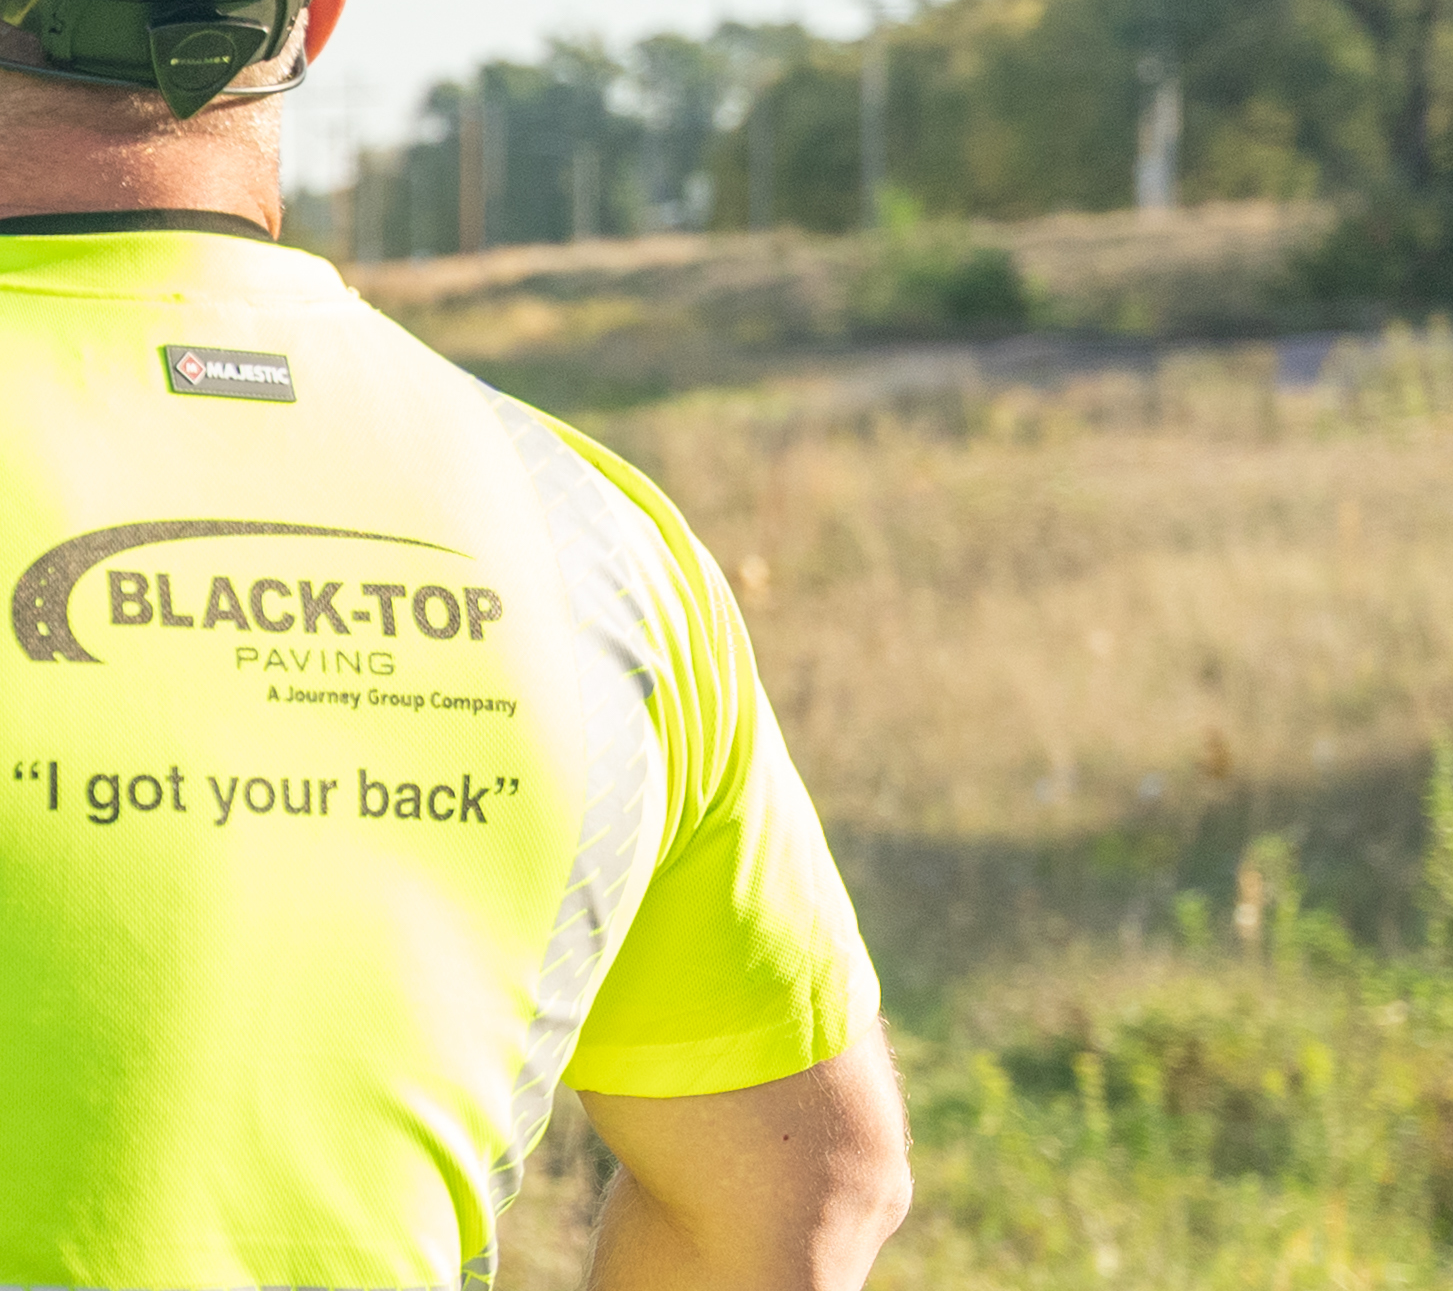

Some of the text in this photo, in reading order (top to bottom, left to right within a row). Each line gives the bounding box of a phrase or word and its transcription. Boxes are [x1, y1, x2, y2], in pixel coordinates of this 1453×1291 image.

[206, 361, 290, 385] MAJESTIC
[107, 571, 503, 641] BLACK-TOP
[235, 647, 395, 676] PAVING
[268, 685, 517, 717] A Journey Group Company
[86, 765, 186, 824] got
[207, 775, 338, 825] your
